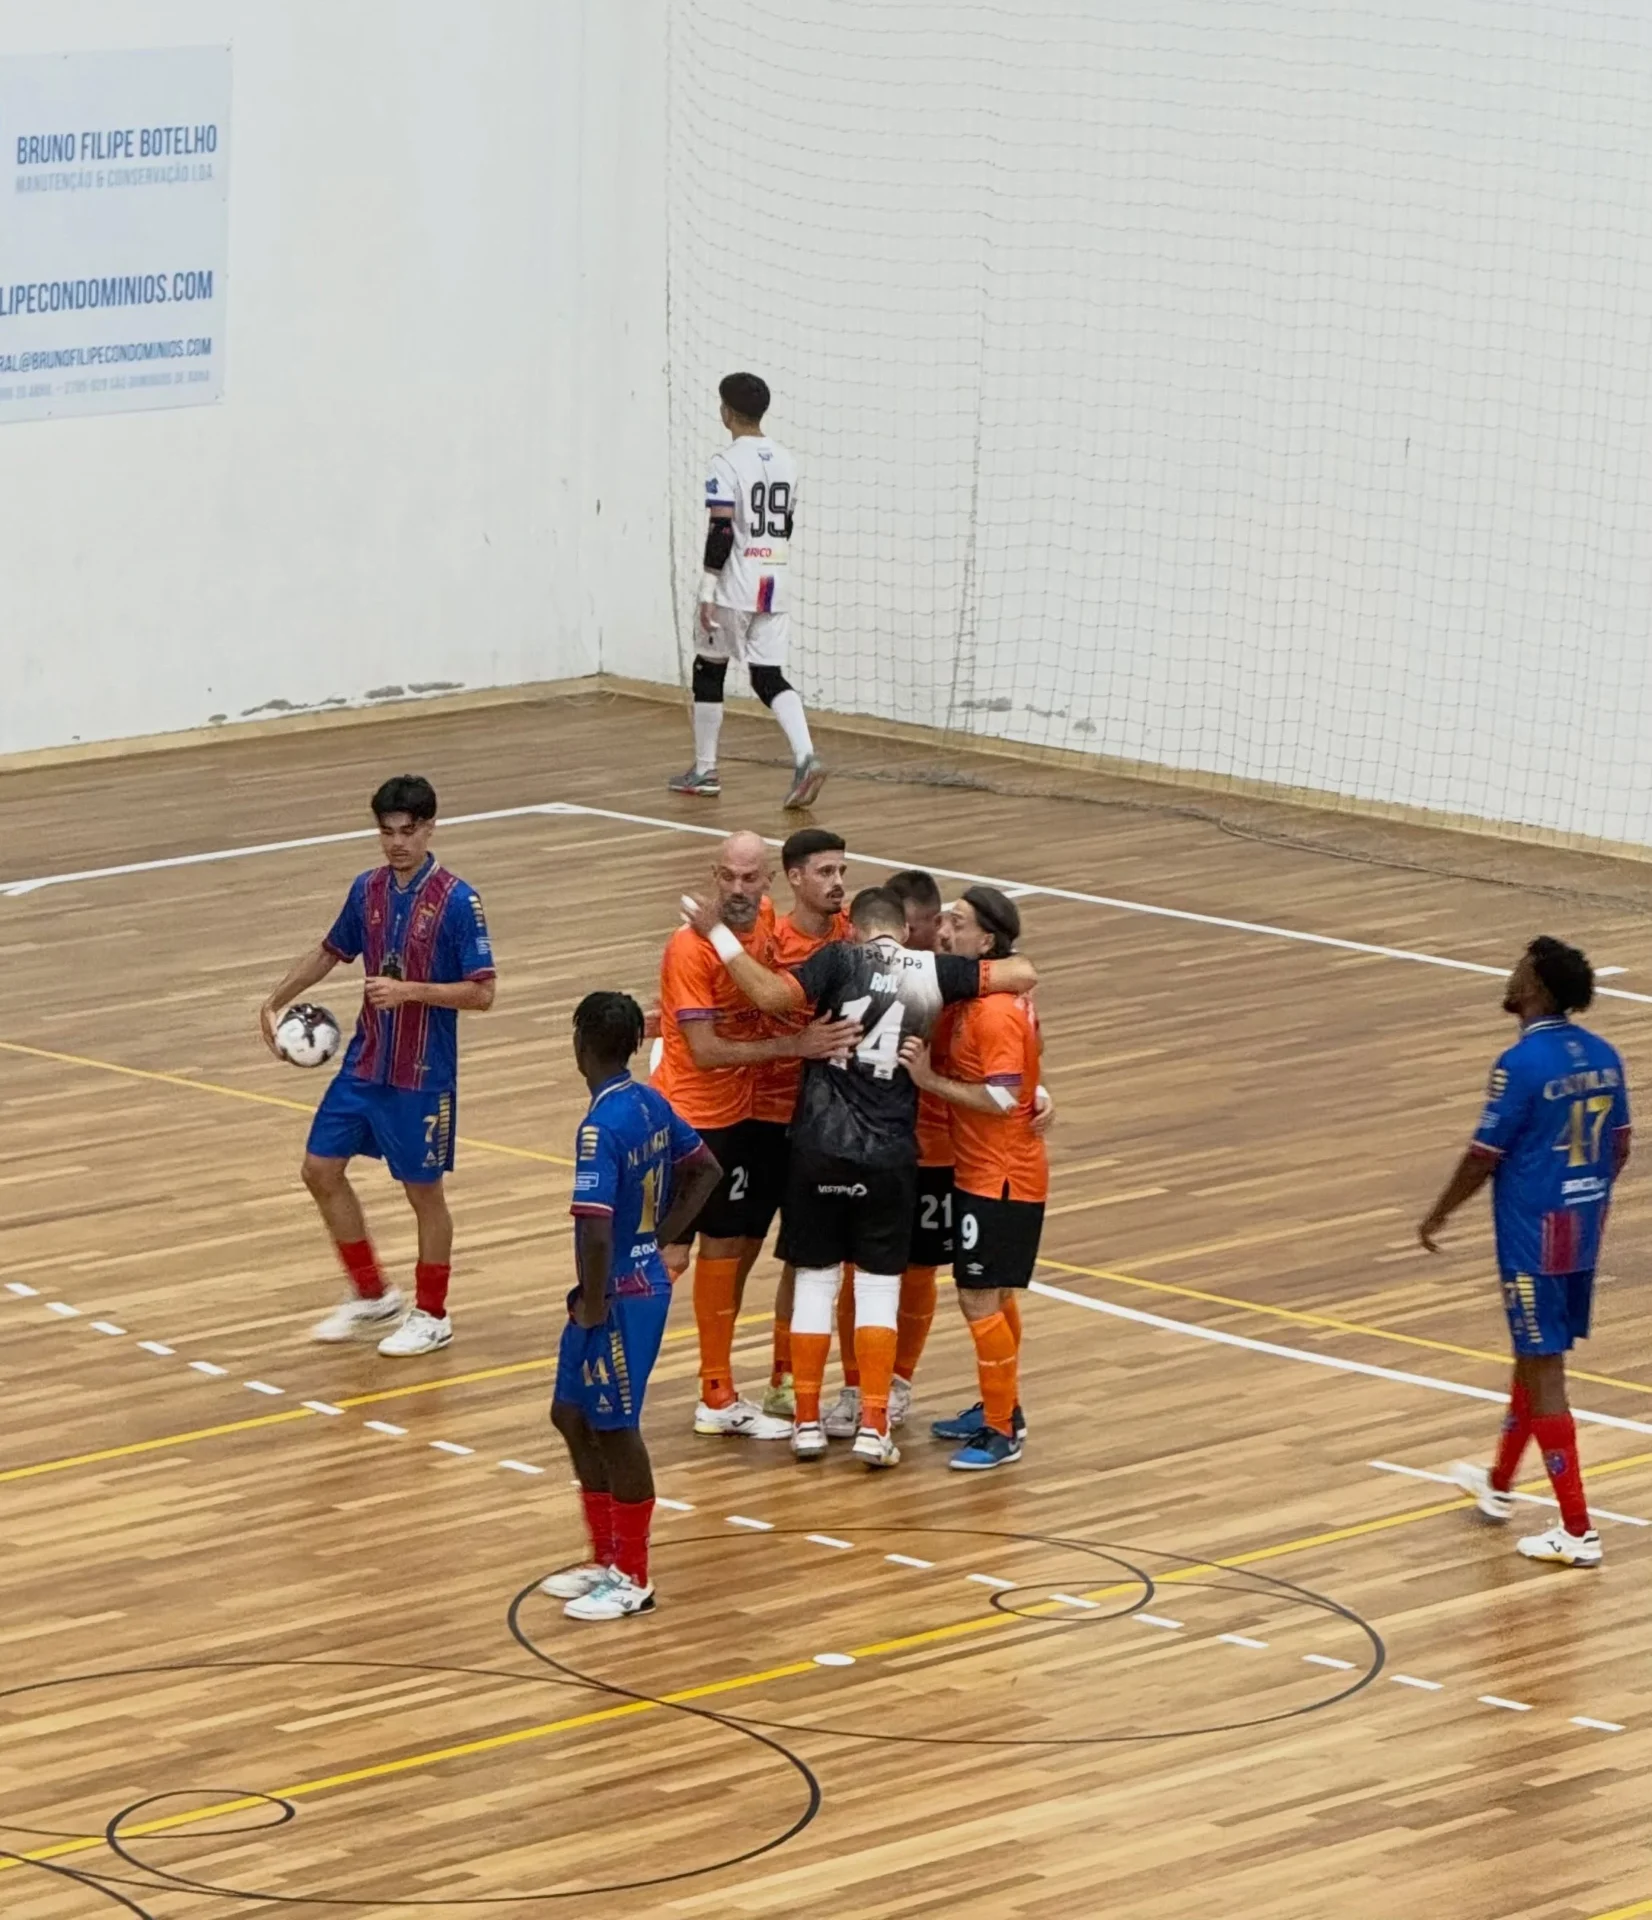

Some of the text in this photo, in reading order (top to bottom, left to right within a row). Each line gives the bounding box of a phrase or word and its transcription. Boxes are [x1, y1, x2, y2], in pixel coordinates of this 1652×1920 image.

[17, 124, 218, 165] BRUNO FILIPE BOTELHO
[15, 167, 93, 195] MANUTENÇÃO
[107, 161, 189, 189] CONSERVAÇÃO
[750, 481, 789, 538] 99
[830, 995, 905, 1080] 14
[423, 1115, 438, 1142] 7
[920, 1193, 952, 1229] 21
[961, 1213, 979, 1250] 9
[582, 1356, 611, 1387] 14
